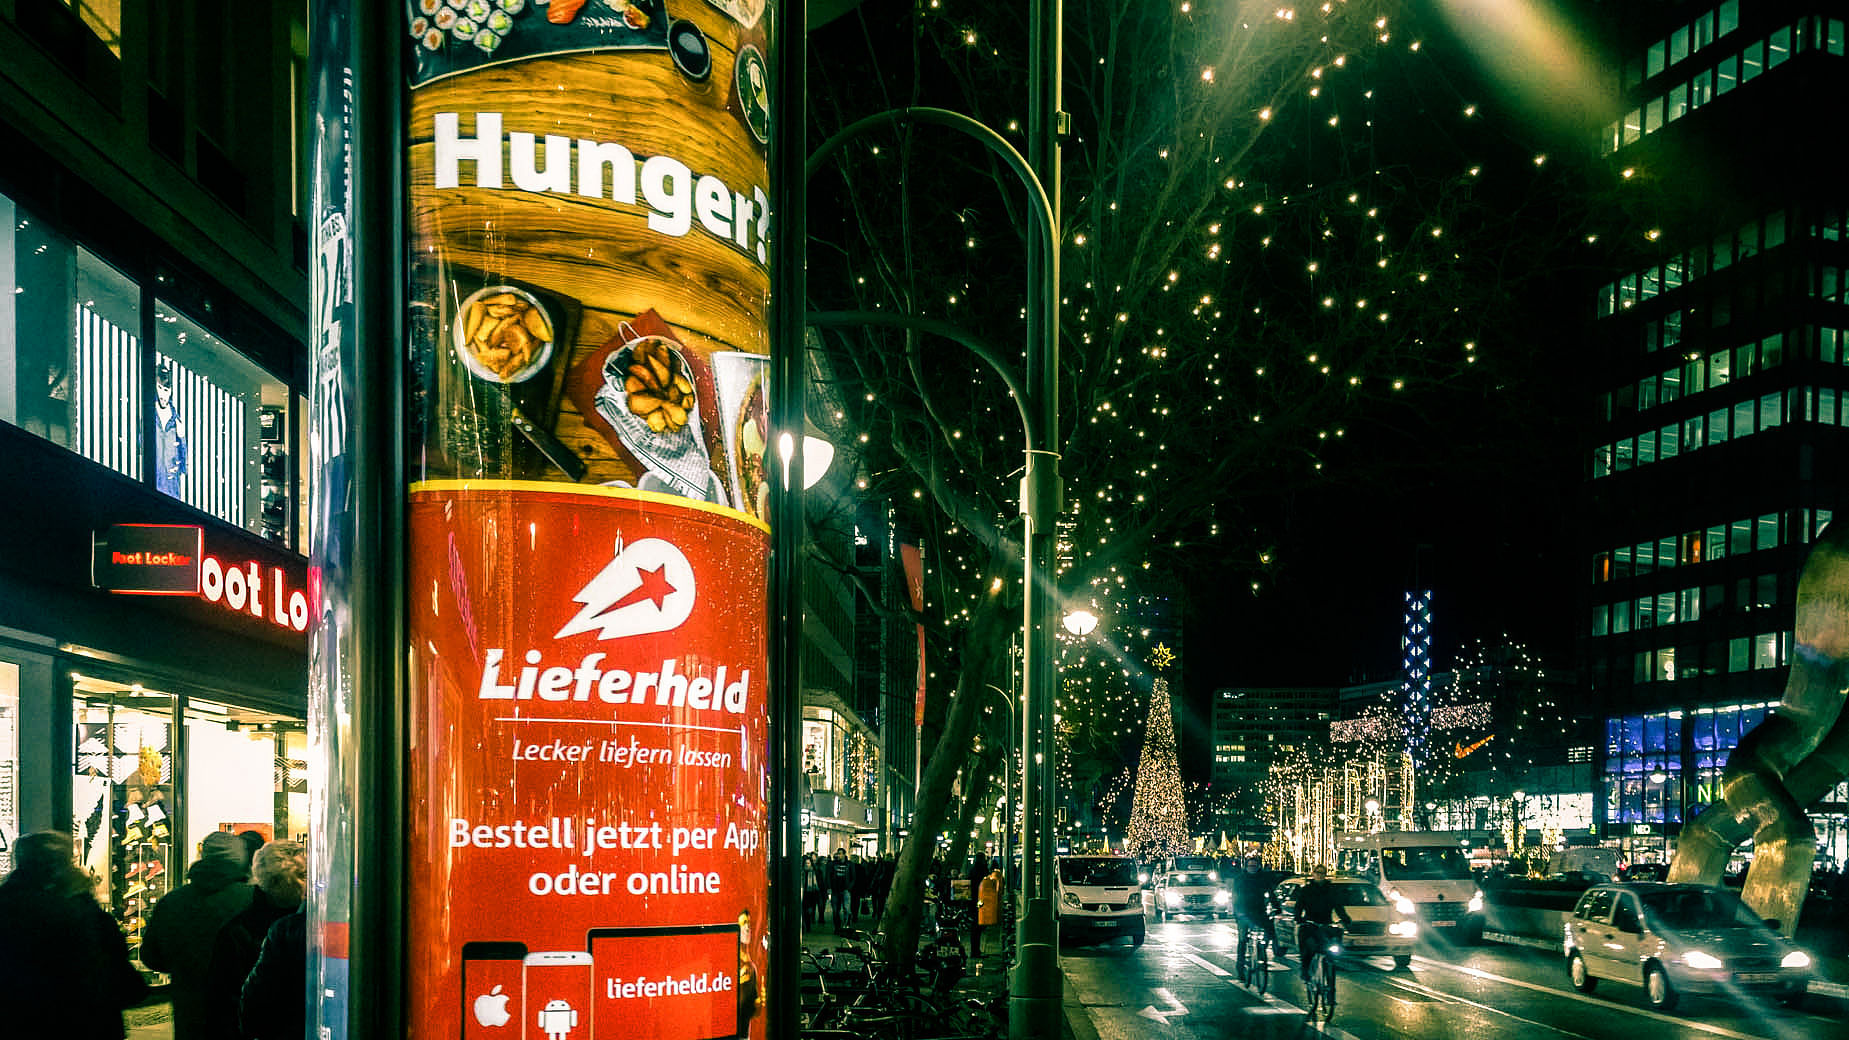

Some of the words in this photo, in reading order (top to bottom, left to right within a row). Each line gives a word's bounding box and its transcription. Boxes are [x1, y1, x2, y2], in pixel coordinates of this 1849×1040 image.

[434, 112, 770, 265] Hunger?
[202, 557, 262, 617] oot
[478, 648, 750, 714] Lieferheld
[512, 739, 593, 762] Lecker
[600, 738, 673, 768] liefern
[679, 743, 731, 768] lassen
[449, 817, 574, 849] Bestell
[583, 819, 662, 857] jetzt
[672, 826, 717, 857] per
[724, 822, 758, 857] App
[1633, 824, 1651, 835] NEO
[528, 864, 617, 896] oder
[627, 864, 721, 896] online
[607, 971, 732, 1000] lieferheld.de
